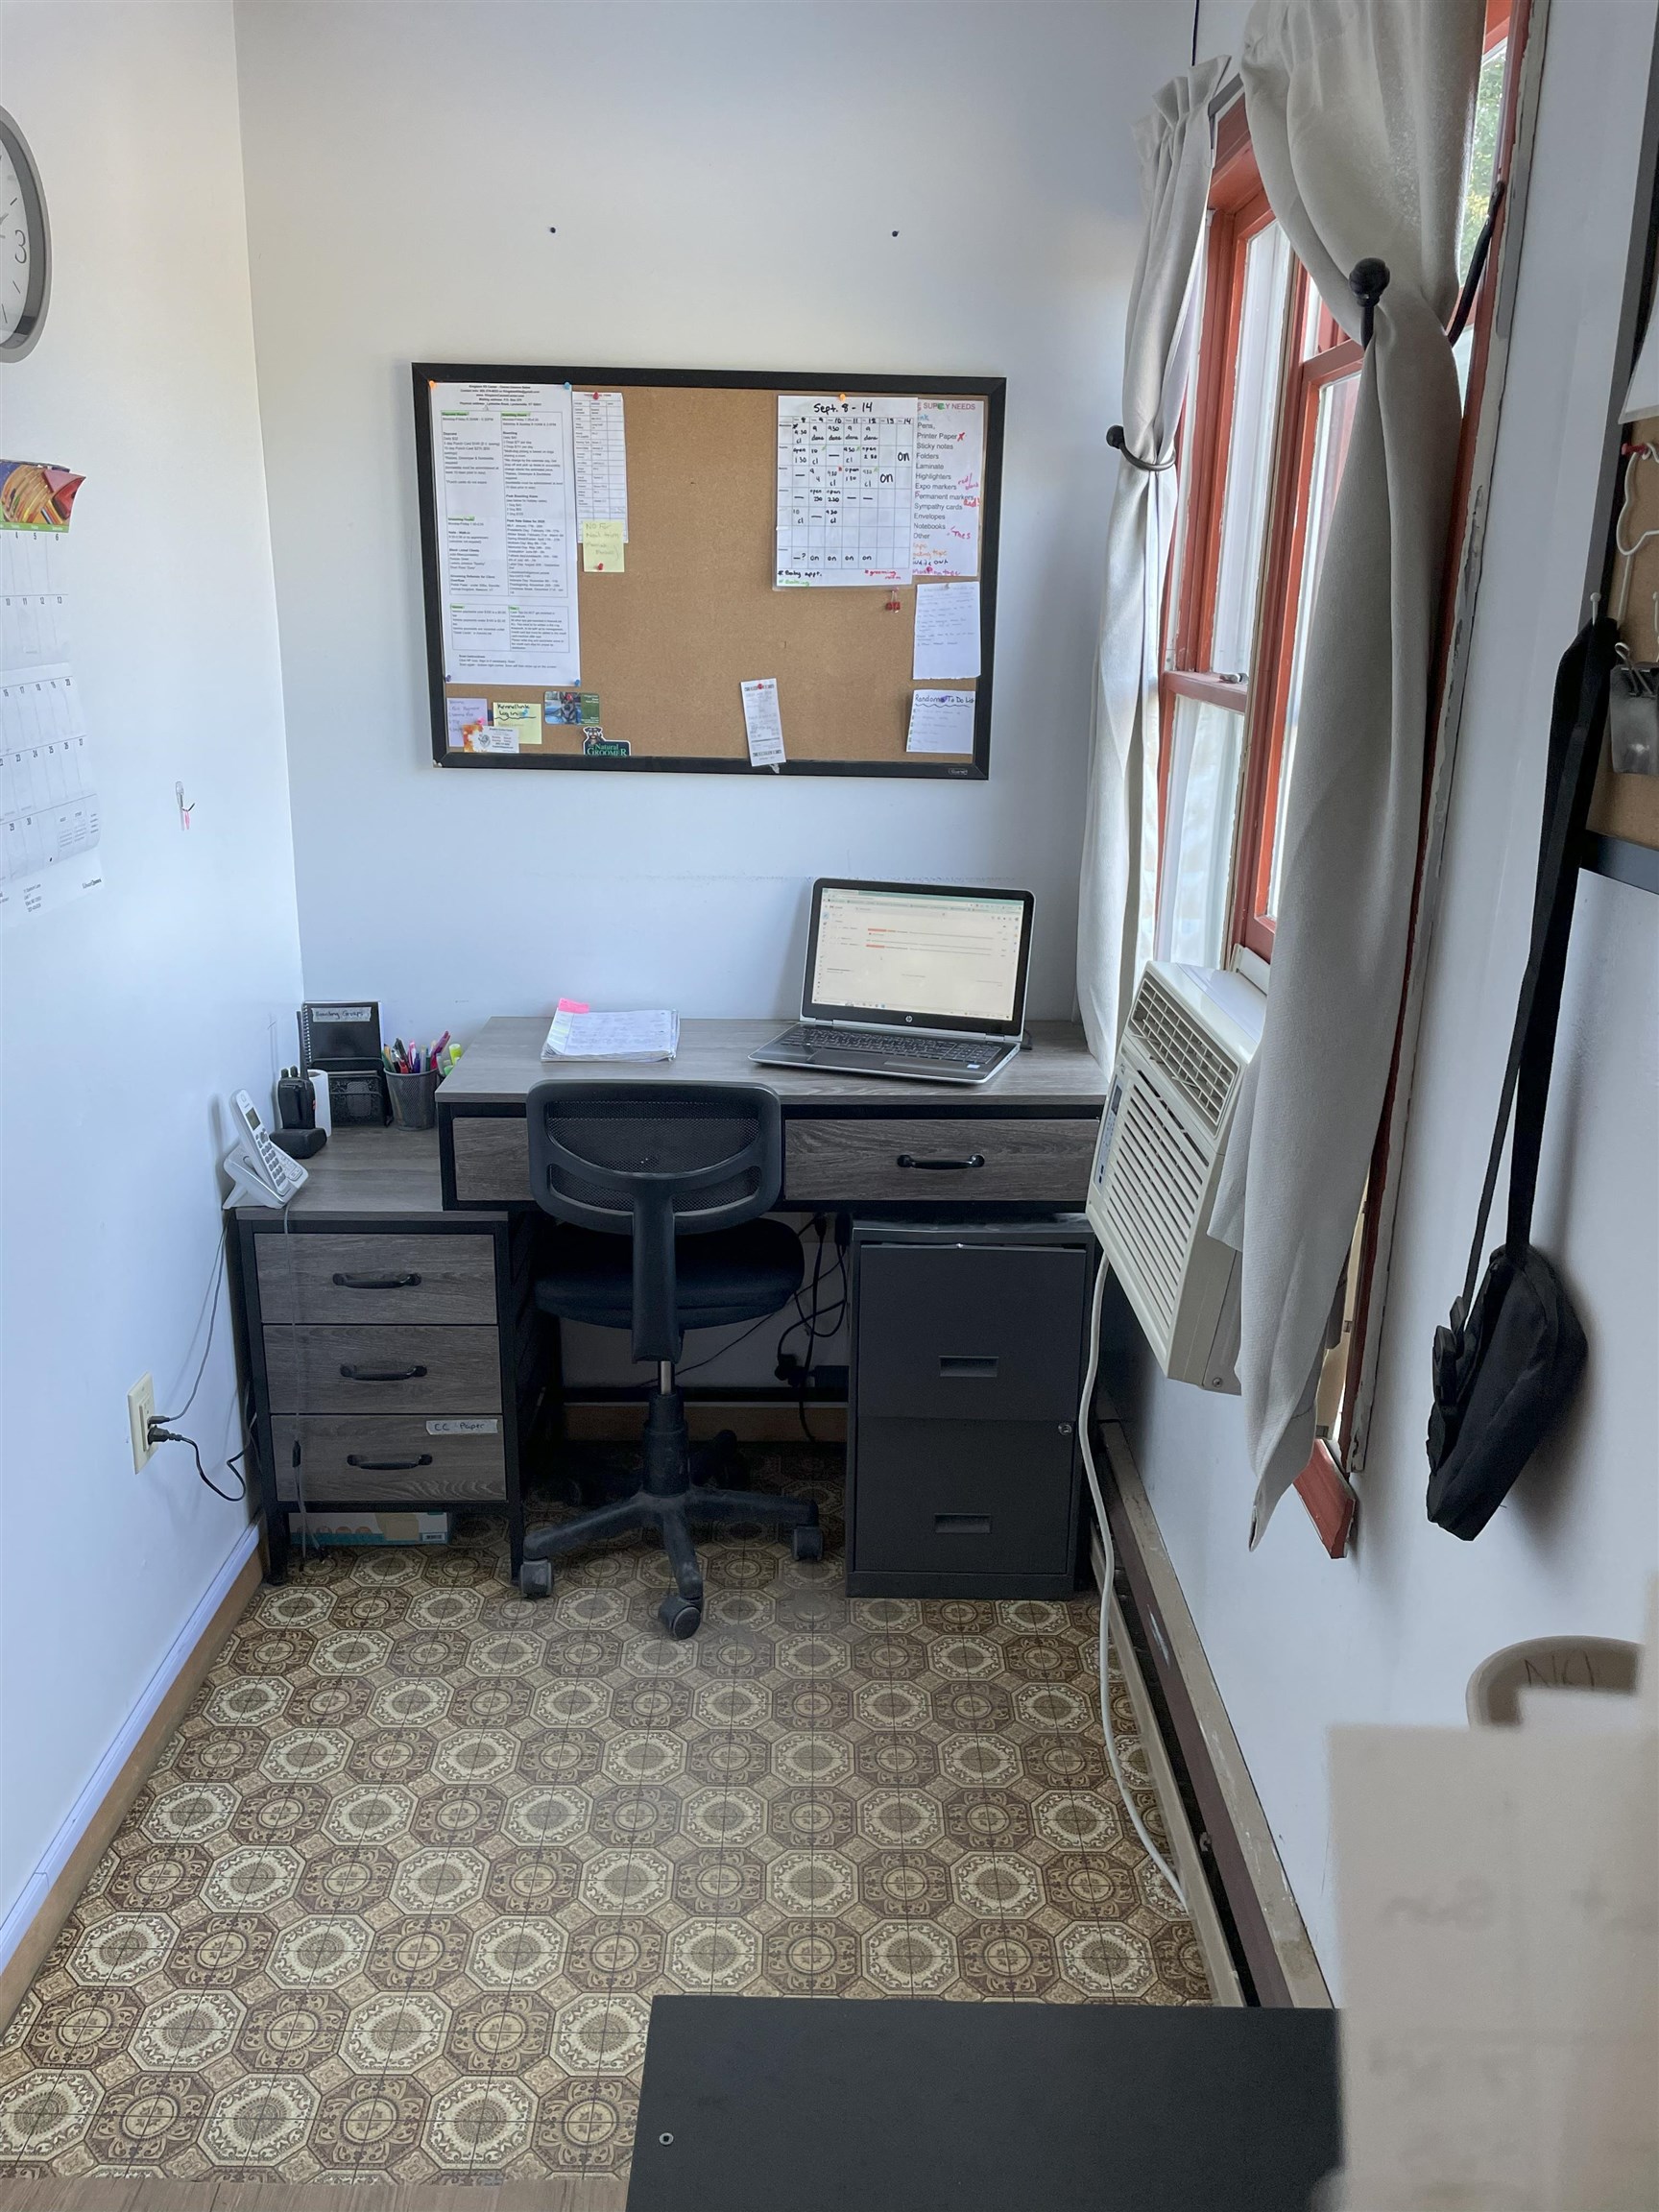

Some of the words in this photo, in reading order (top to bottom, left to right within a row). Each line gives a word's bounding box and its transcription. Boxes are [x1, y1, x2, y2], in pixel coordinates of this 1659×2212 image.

[14, 229, 27, 264] 3
[814, 403, 838, 415] Sept.
[841, 403, 849, 412] 8
[862, 402, 873, 413] 14
[898, 452, 909, 461] on
[879, 473, 894, 483] on
[915, 472, 951, 481] Highlighters
[55, 533, 60, 541] 6
[434, 1423, 449, 1431] CC
